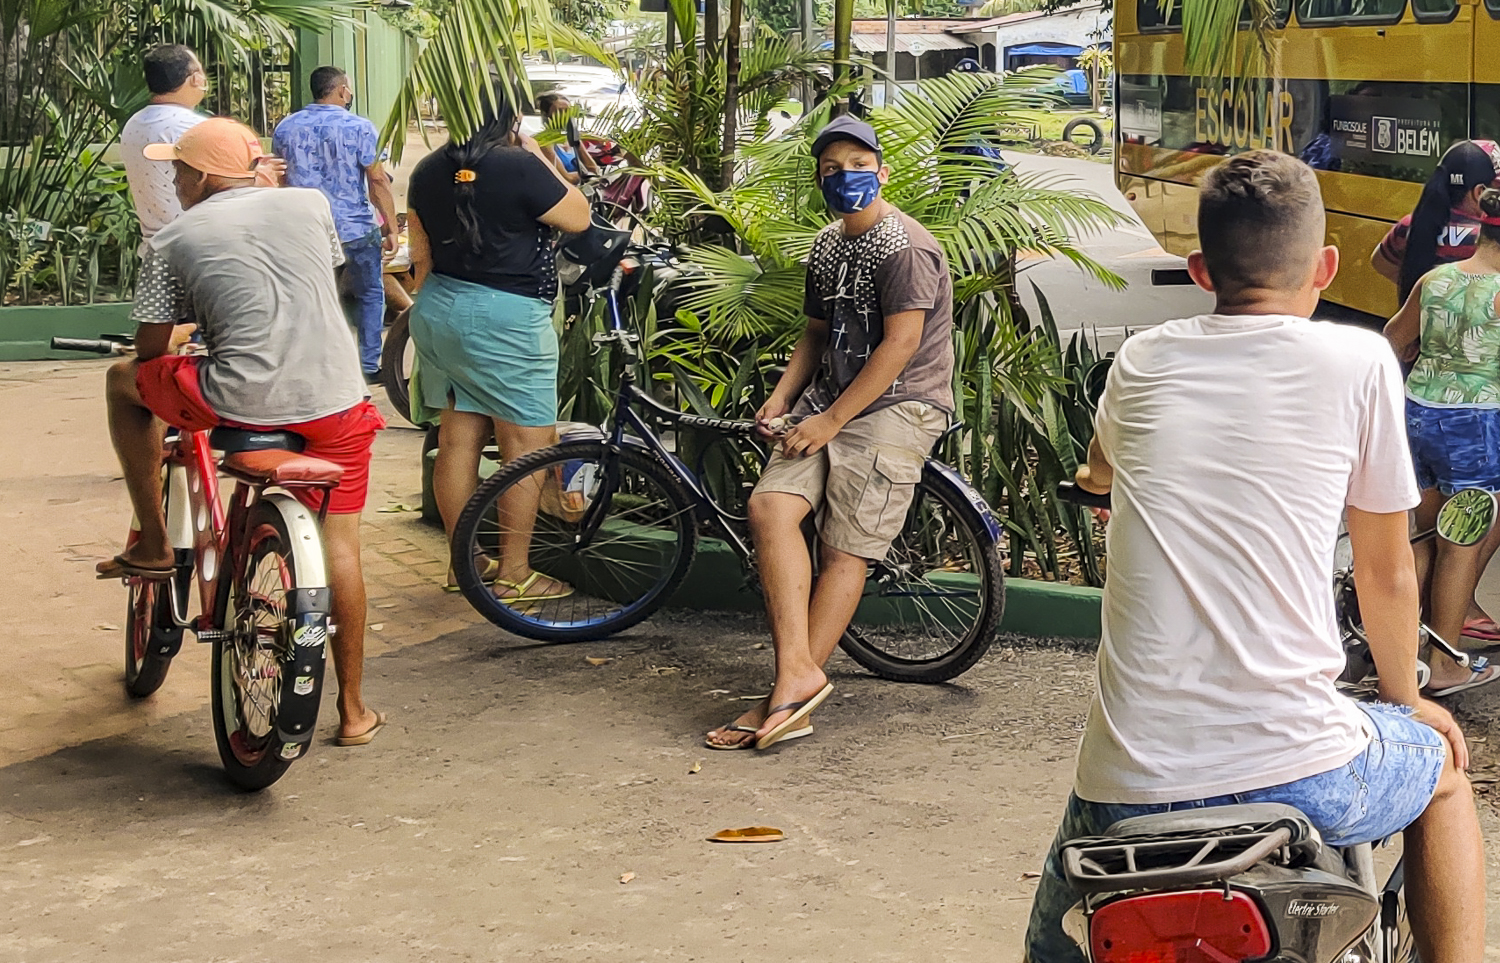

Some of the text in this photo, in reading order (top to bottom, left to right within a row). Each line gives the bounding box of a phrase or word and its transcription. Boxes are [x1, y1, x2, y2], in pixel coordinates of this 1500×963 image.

[1195, 88, 1294, 154] ESCOLAR
[1333, 119, 1367, 134] FUNBOSQUE
[1397, 127, 1440, 158] BELÉM
[678, 415, 754, 431] monark
[1287, 900, 1340, 916] Electric Starter
